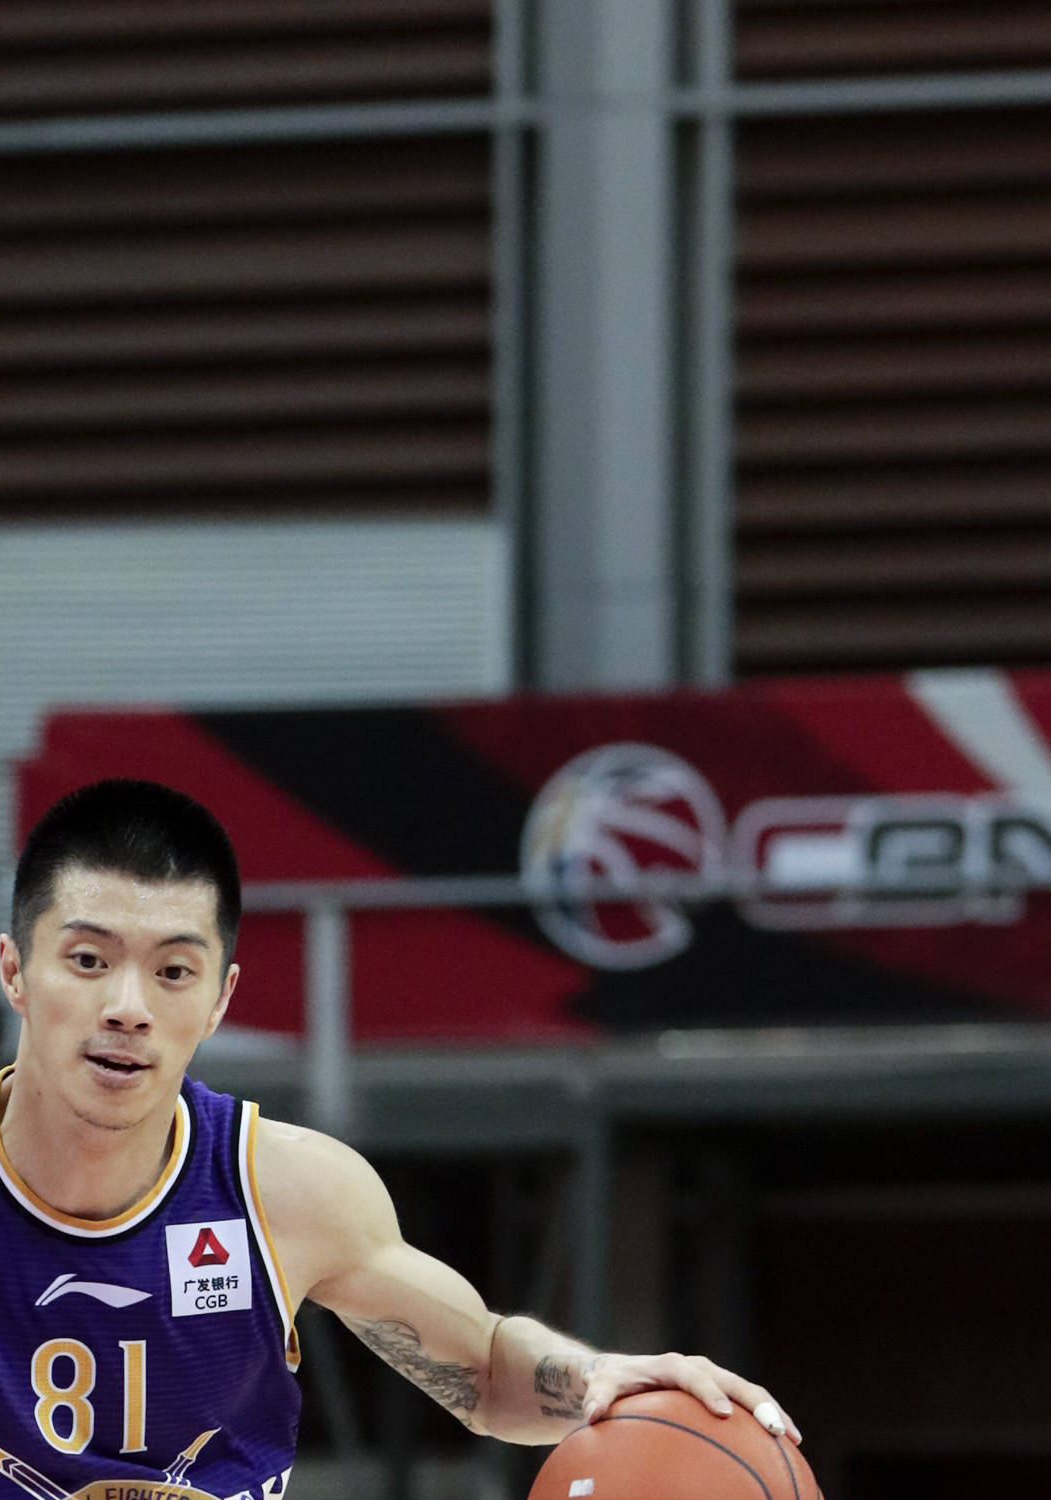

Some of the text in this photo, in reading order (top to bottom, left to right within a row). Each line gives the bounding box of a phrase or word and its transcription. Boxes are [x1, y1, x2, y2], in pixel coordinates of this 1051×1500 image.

[183, 1275, 239, 1294] 广发银行
[194, 1294, 228, 1310] CGB
[31, 1337, 149, 1455] 81
